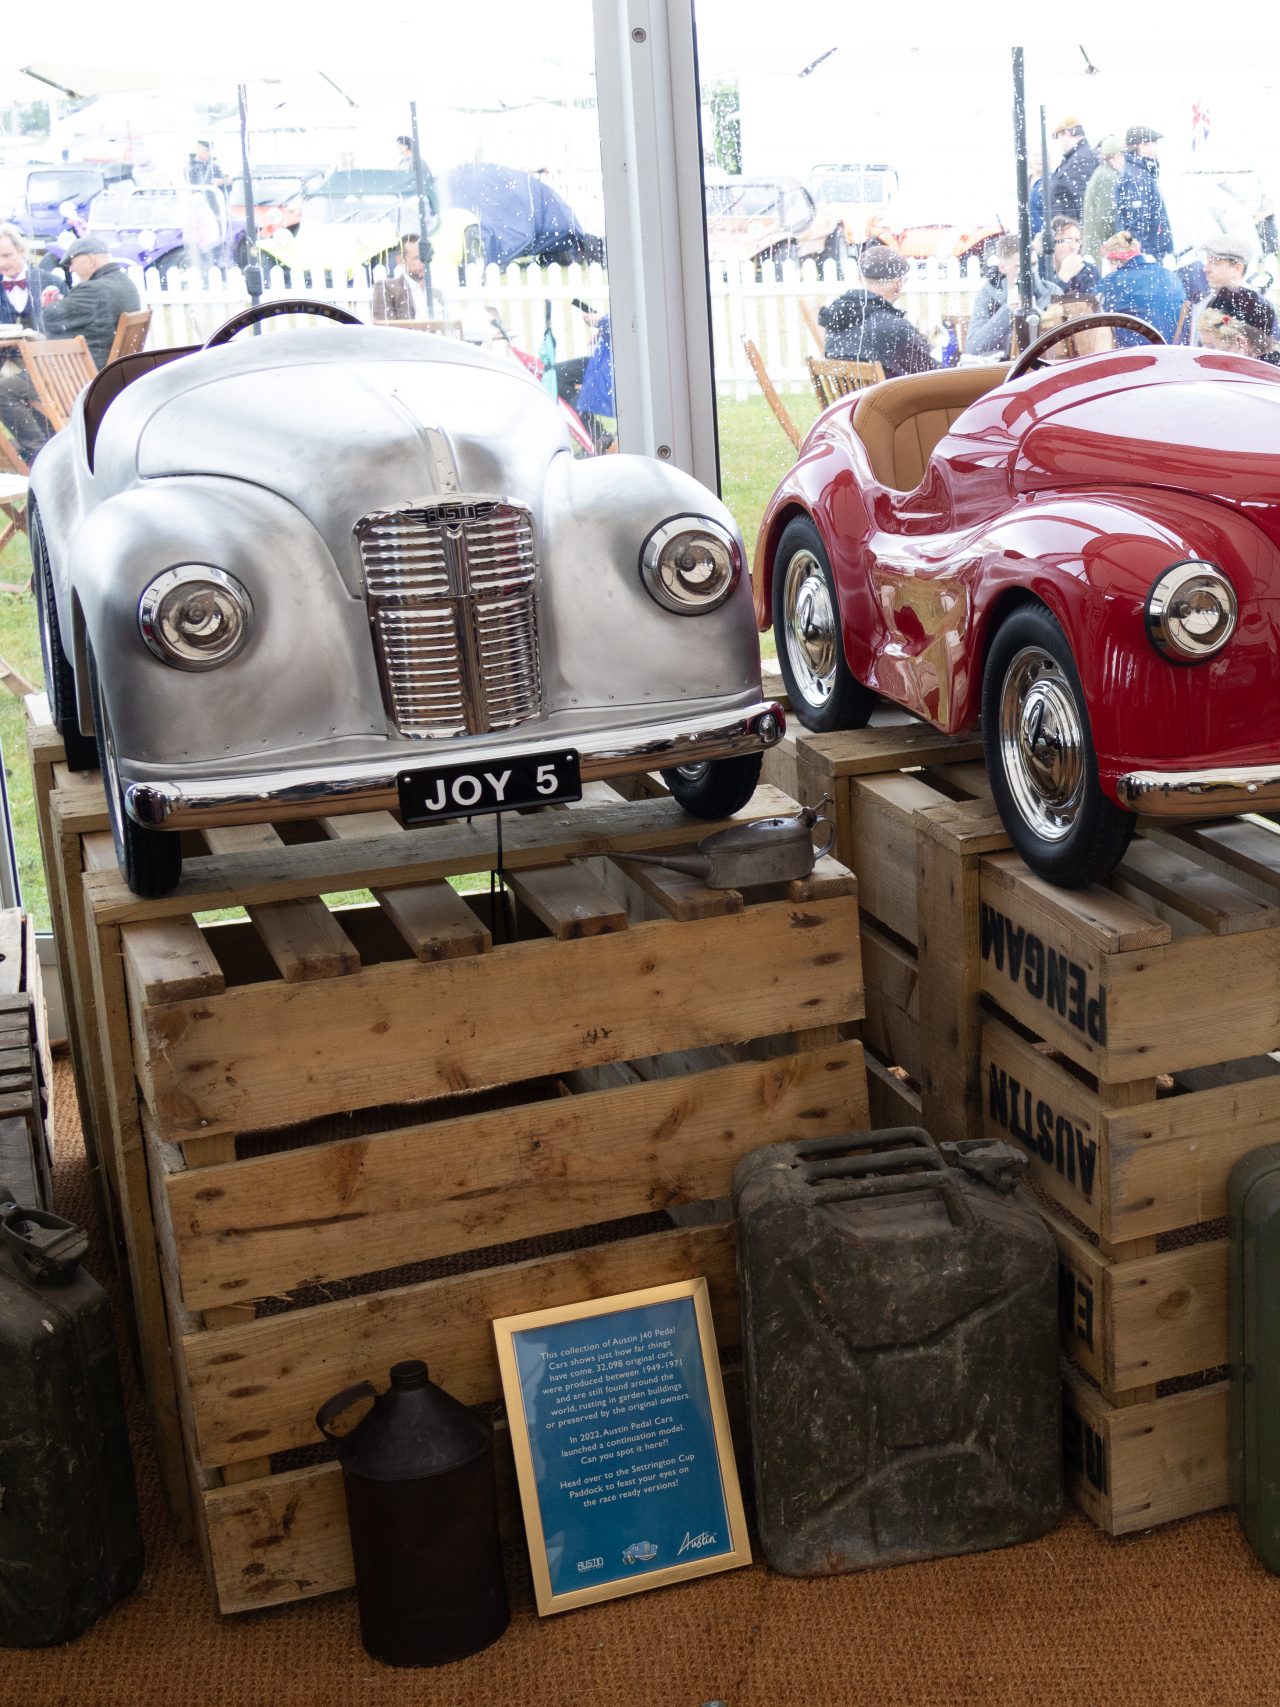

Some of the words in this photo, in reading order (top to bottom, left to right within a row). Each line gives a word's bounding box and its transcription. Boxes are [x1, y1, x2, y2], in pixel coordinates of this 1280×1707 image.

[427, 505, 477, 524] AUSTIN
[425, 769, 512, 811] JOY
[536, 764, 559, 795] 5
[980, 902, 1107, 1047] PENGAM
[990, 1061, 1098, 1197] AUSTIN
[540, 1352, 557, 1360] This
[561, 1344, 599, 1356] collection
[602, 1340, 611, 1348] of
[612, 1336, 638, 1346] Austin
[640, 1331, 652, 1342] J40
[655, 1326, 676, 1336] Pedal
[548, 1362, 567, 1370] Cars
[571, 1356, 595, 1366] shows
[598, 1353, 613, 1361] just
[634, 1344, 645, 1352] far
[648, 1340, 671, 1350] things
[549, 1373, 567, 1381] have
[626, 1354, 655, 1366] original
[542, 1387, 562, 1395] were
[565, 1378, 603, 1391] produced
[606, 1370, 639, 1381] between
[556, 1396, 571, 1404] and
[589, 1388, 603, 1397] still
[605, 1383, 628, 1393] found
[631, 1377, 658, 1388] around
[551, 1405, 577, 1416] world,
[580, 1399, 606, 1410] rusting
[619, 1390, 645, 1404] garden
[648, 1384, 682, 1395] buildings
[559, 1412, 598, 1428] preserved
[601, 1410, 610, 1418] by
[612, 1406, 626, 1414] the
[628, 1399, 658, 1411] original
[660, 1394, 690, 1404] owners.
[562, 1444, 597, 1456] launched
[606, 1433, 656, 1447] continuation
[658, 1424, 685, 1435] model.
[603, 1426, 628, 1437] Austin
[631, 1421, 652, 1430] Pedal
[654, 1416, 673, 1425] Cars
[580, 1456, 597, 1464] Can
[599, 1452, 614, 1462] you
[616, 1448, 634, 1457] spot
[560, 1479, 581, 1489] Head
[584, 1474, 602, 1484] over
[632, 1458, 675, 1473] Settrington
[679, 1454, 695, 1462] Cup
[569, 1486, 604, 1498] Paddock
[617, 1478, 636, 1488] feast
[638, 1474, 657, 1484] your
[659, 1470, 676, 1479] eyes
[583, 1499, 596, 1507] the
[600, 1495, 616, 1503] race
[619, 1489, 640, 1499] ready
[643, 1479, 679, 1493] versions!
[677, 1532, 717, 1556] Austin
